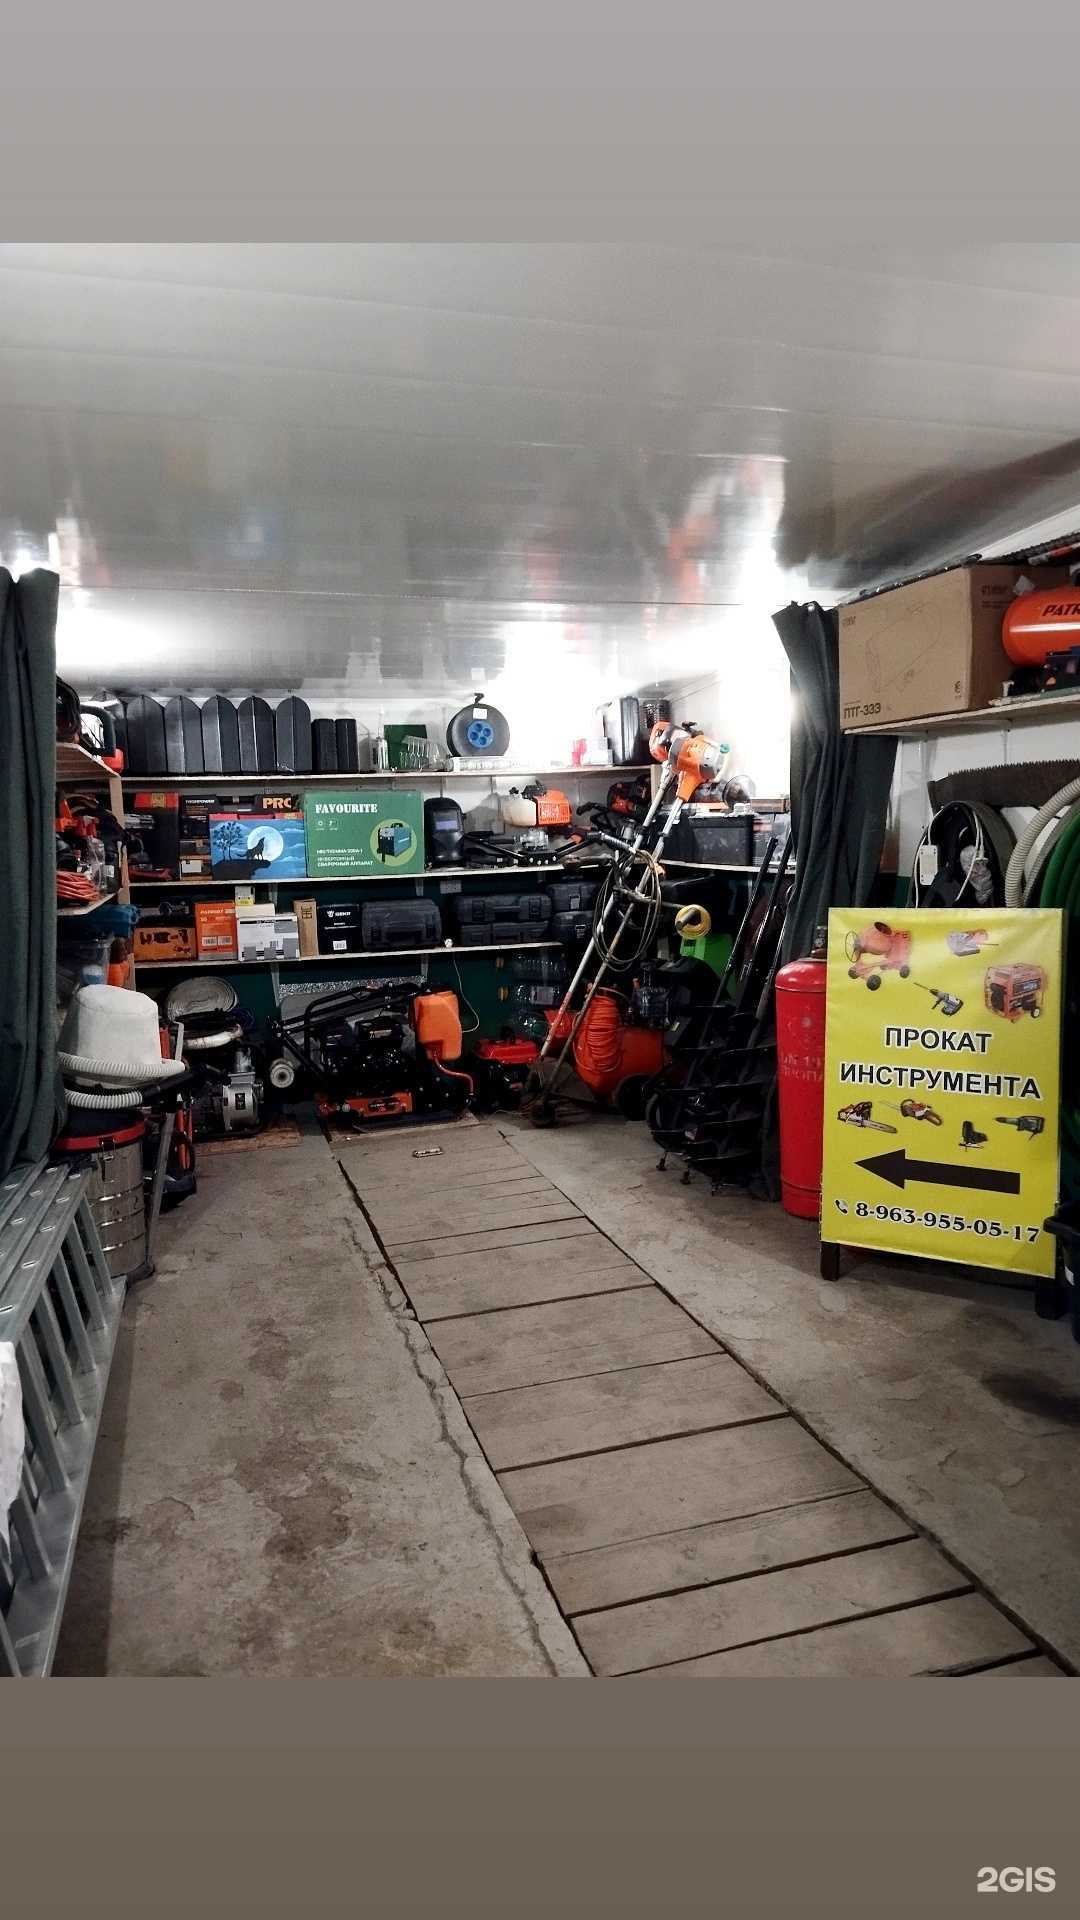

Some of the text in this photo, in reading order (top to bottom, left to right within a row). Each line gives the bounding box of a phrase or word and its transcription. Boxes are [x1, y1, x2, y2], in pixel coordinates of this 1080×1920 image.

[315, 803, 378, 814] FAVOURITE
[885, 1027, 992, 1053] ПРОКАТ
[840, 1062, 1041, 1099] ИНСТРУМЕНТА
[855, 1202, 1040, 1243] 8-963-955-05-17
